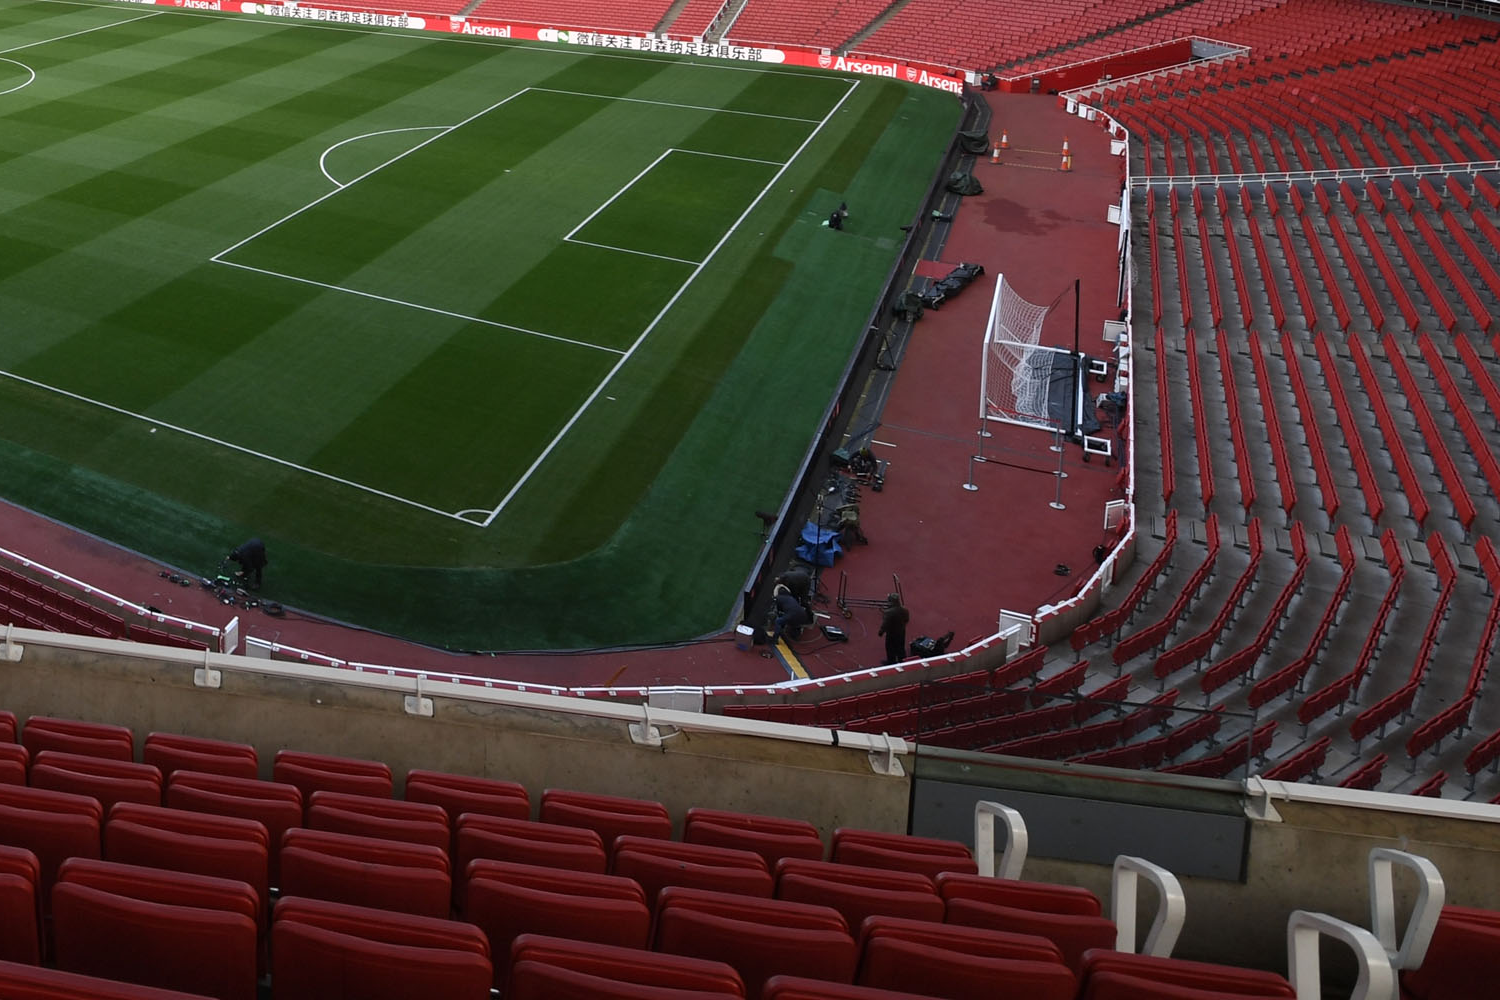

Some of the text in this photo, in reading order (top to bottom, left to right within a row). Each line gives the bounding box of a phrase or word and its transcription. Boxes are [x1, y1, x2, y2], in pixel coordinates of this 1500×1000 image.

[271, 5, 408, 28] 微信关注 阿森纳足球俱乐部
[462, 21, 511, 38] Arsenal
[577, 31, 762, 61] 微信关注 阿森纳足球俱乐部
[834, 56, 897, 78] Arsenal
